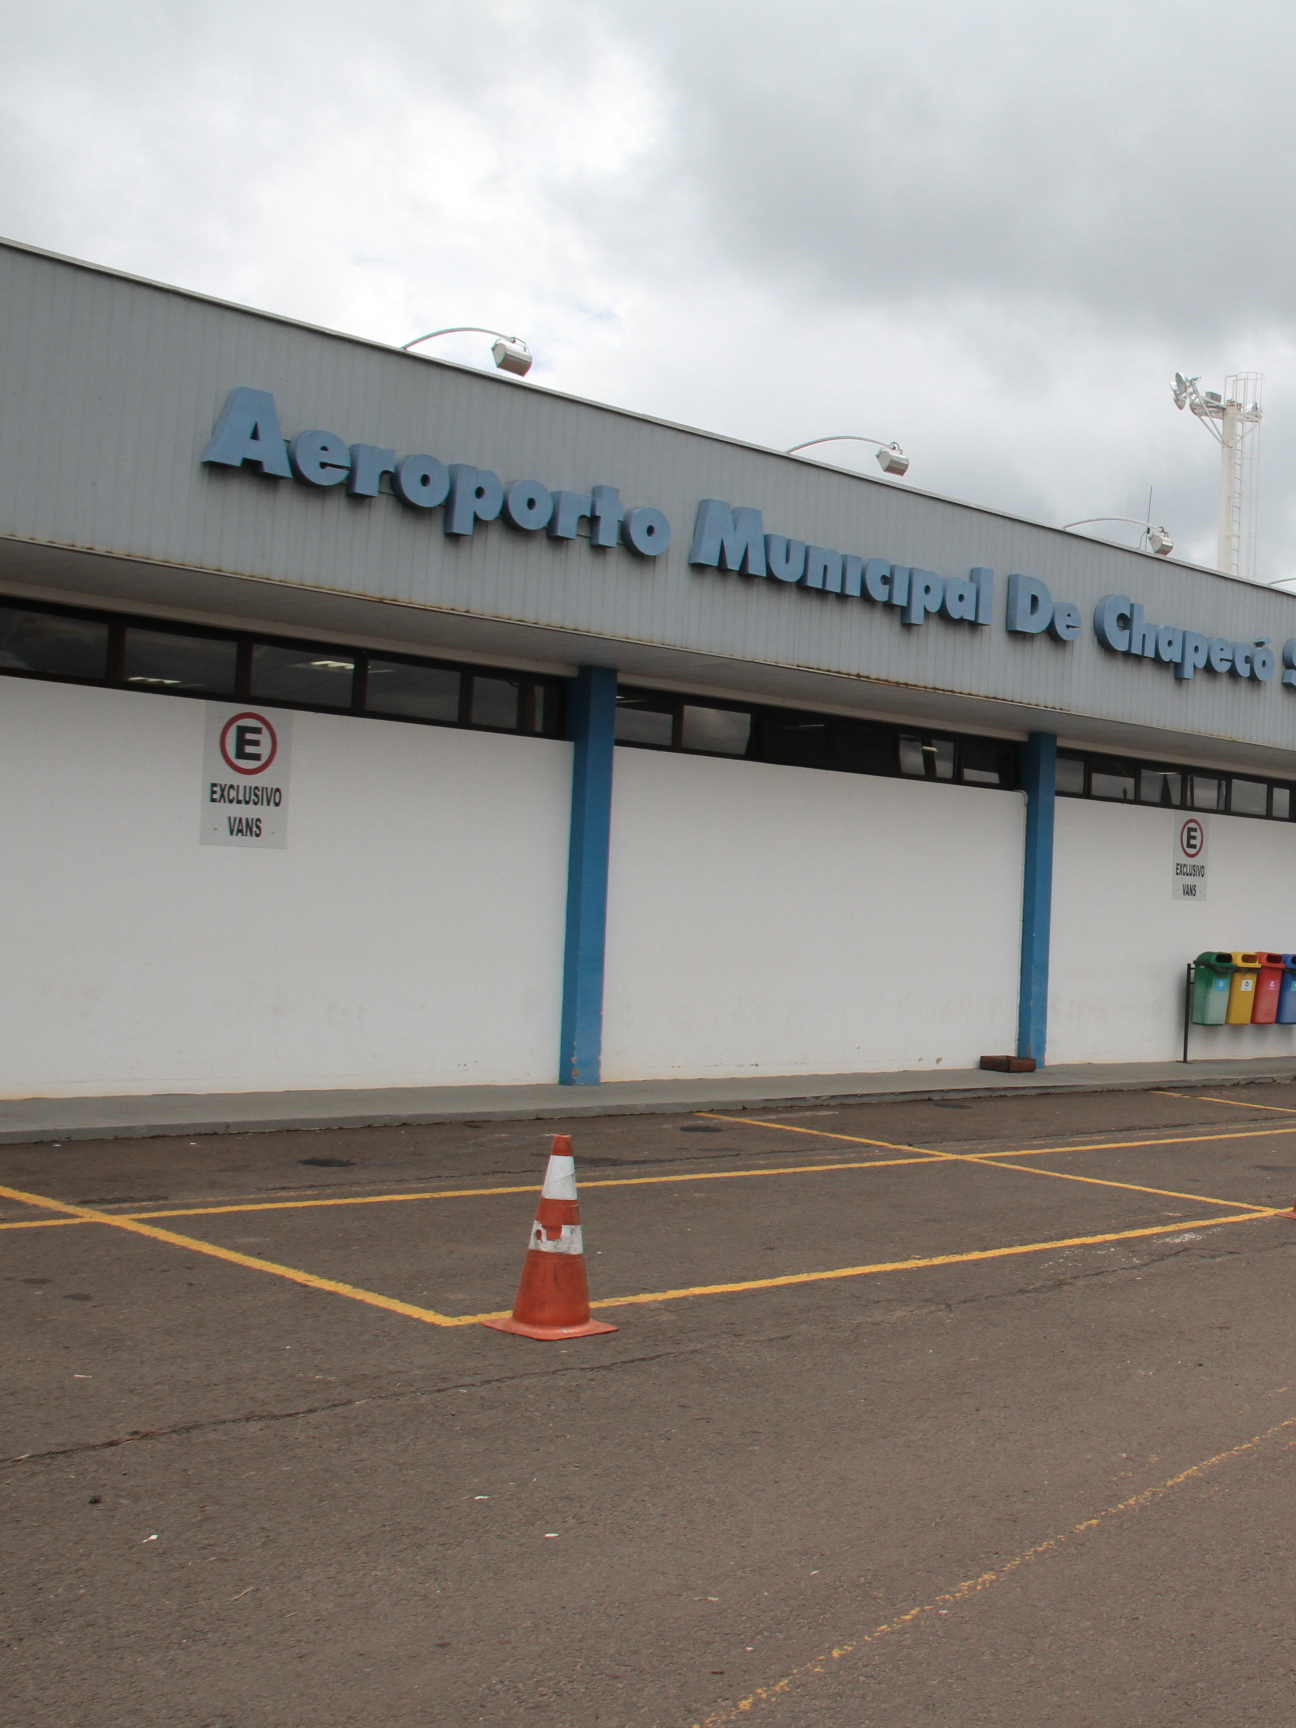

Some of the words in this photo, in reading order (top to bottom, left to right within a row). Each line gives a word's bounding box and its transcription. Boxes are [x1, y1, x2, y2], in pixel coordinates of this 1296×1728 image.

[201, 386, 671, 557] Aeroporto
[688, 498, 992, 628] Municipal
[1006, 573, 1082, 641] De
[1093, 594, 1275, 682] Chapecó
[235, 725, 262, 761] E
[209, 783, 282, 807] EXCLUSIVO
[228, 816, 262, 837] VANS
[1186, 827, 1198, 849] E
[1176, 863, 1205, 877] EXCLUSIVO
[1182, 884, 1197, 897] VANS
